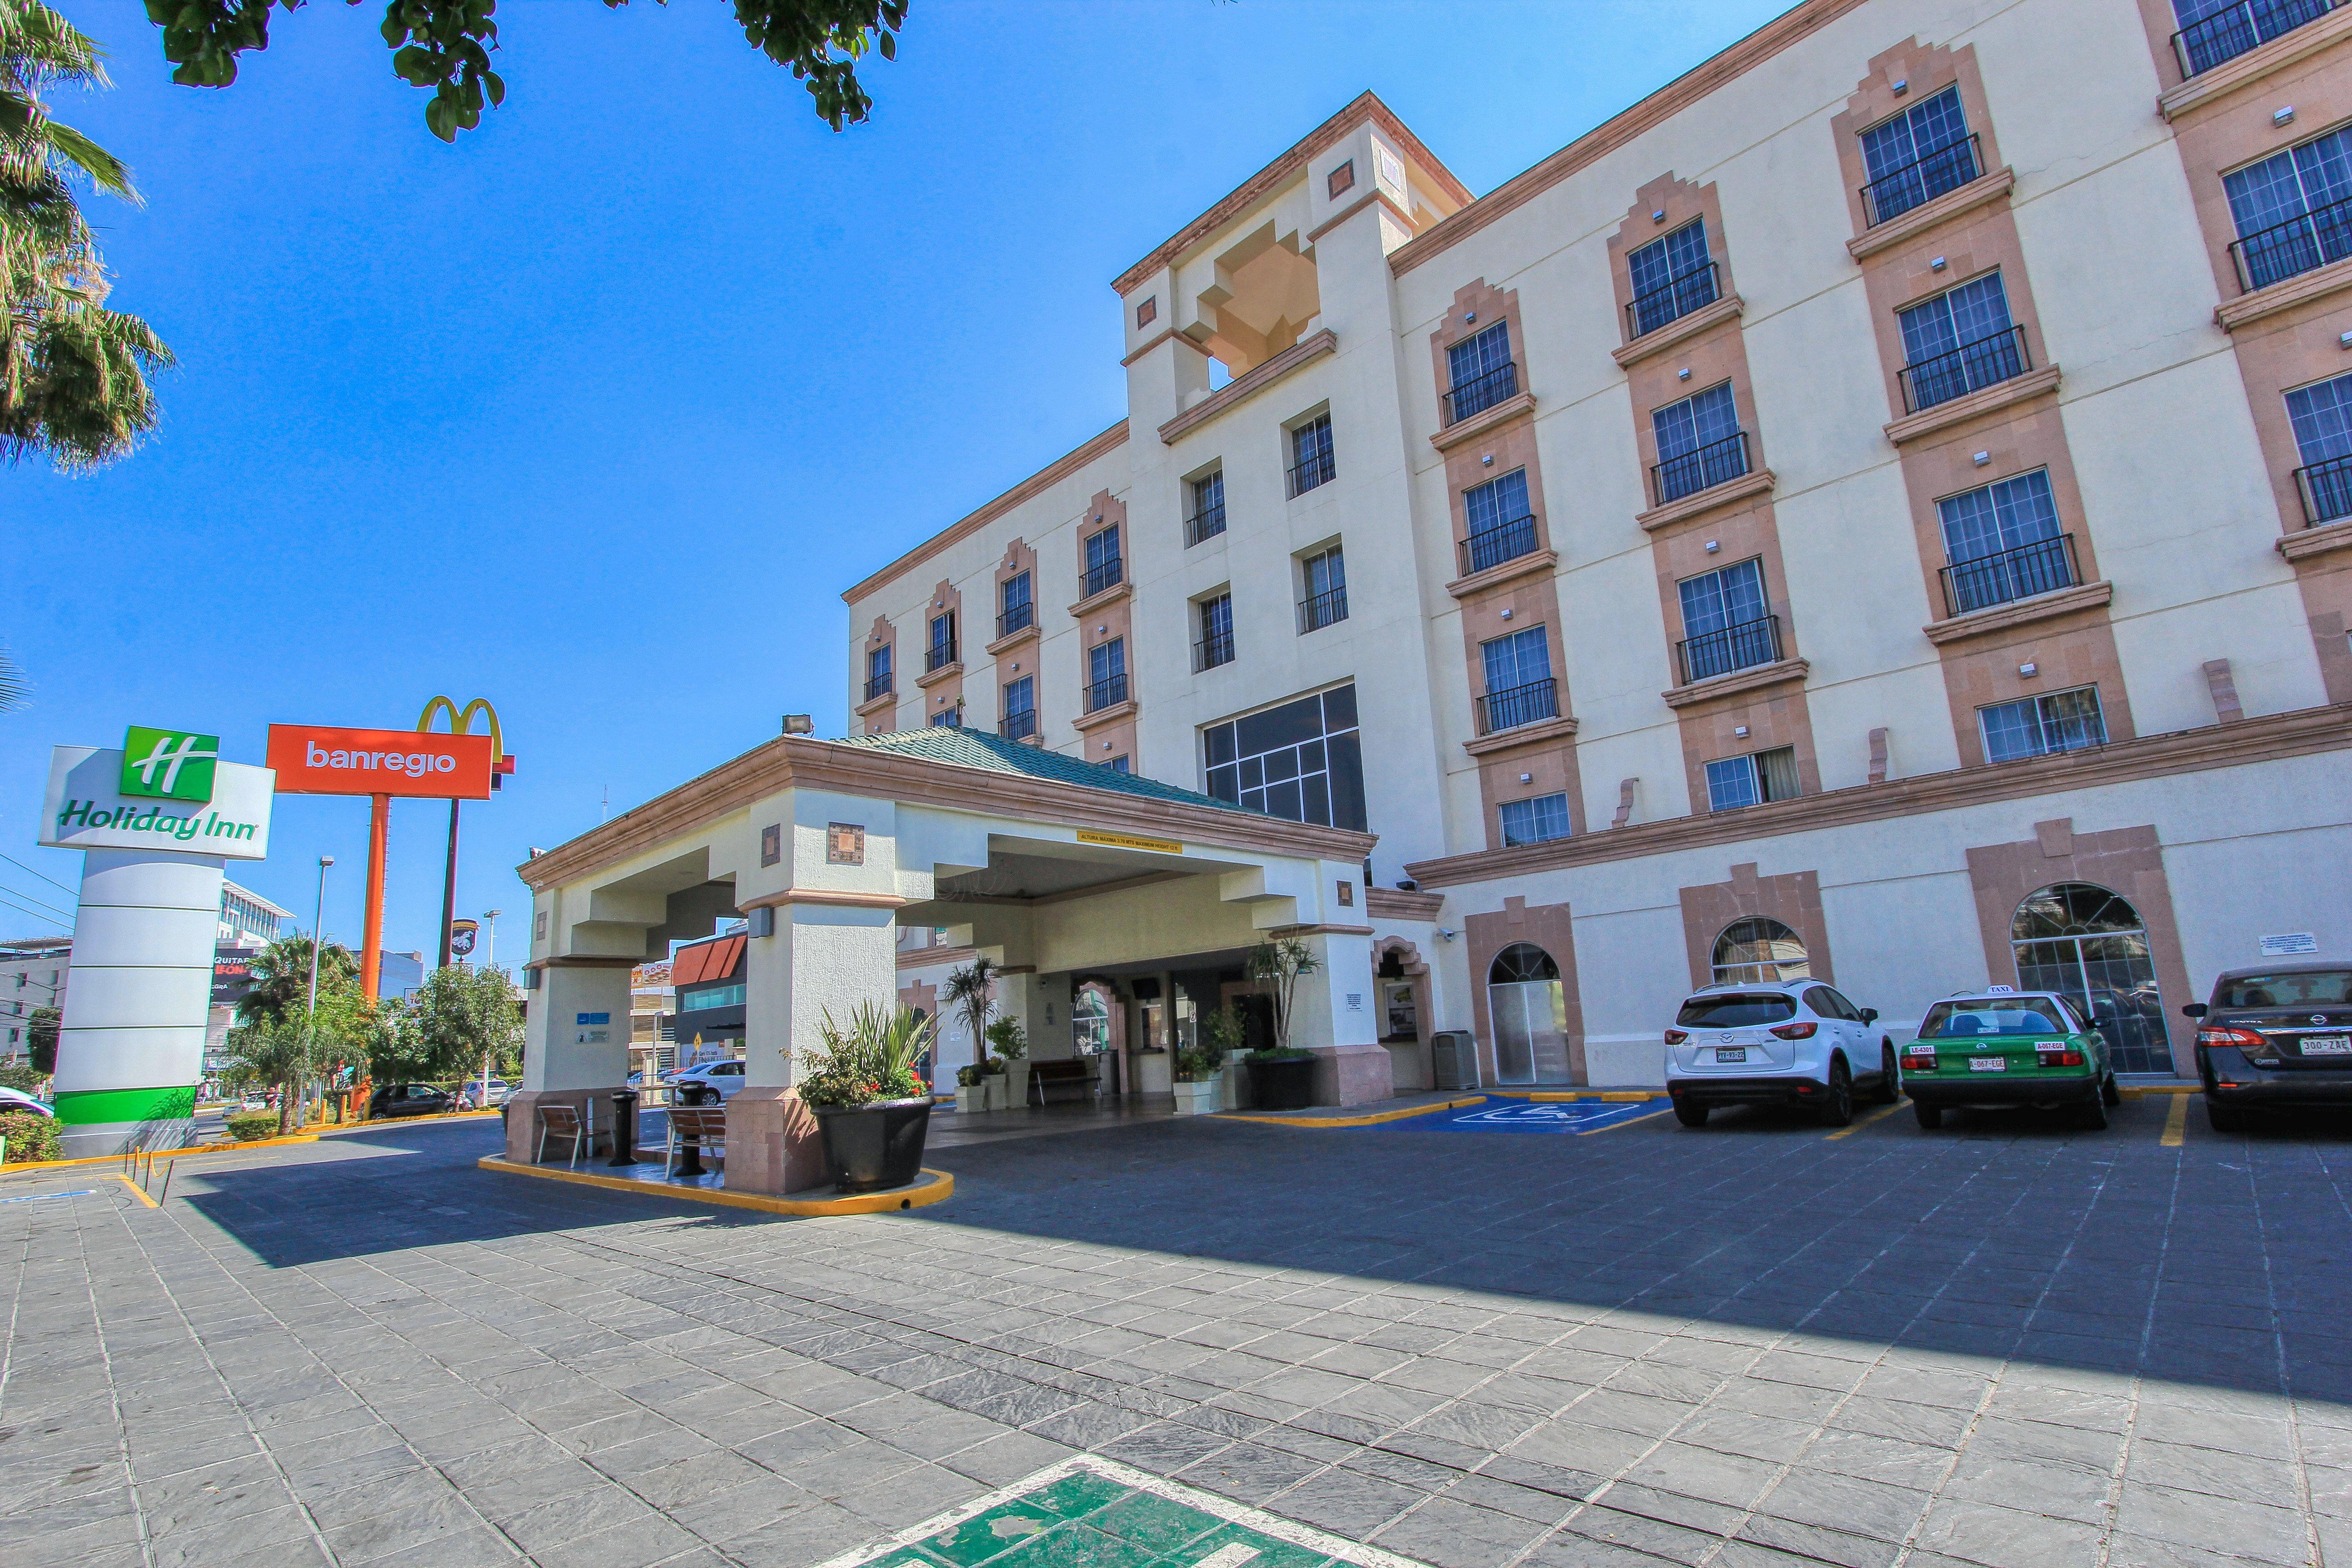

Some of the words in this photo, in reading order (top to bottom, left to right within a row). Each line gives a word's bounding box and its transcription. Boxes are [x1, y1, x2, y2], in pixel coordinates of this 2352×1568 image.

[306, 740, 457, 778] banregio
[59, 799, 202, 841] Holiday
[2304, 1040, 2347, 1049] 300-ZAE
[1969, 1059, 2004, 1068] A-067-EGE
